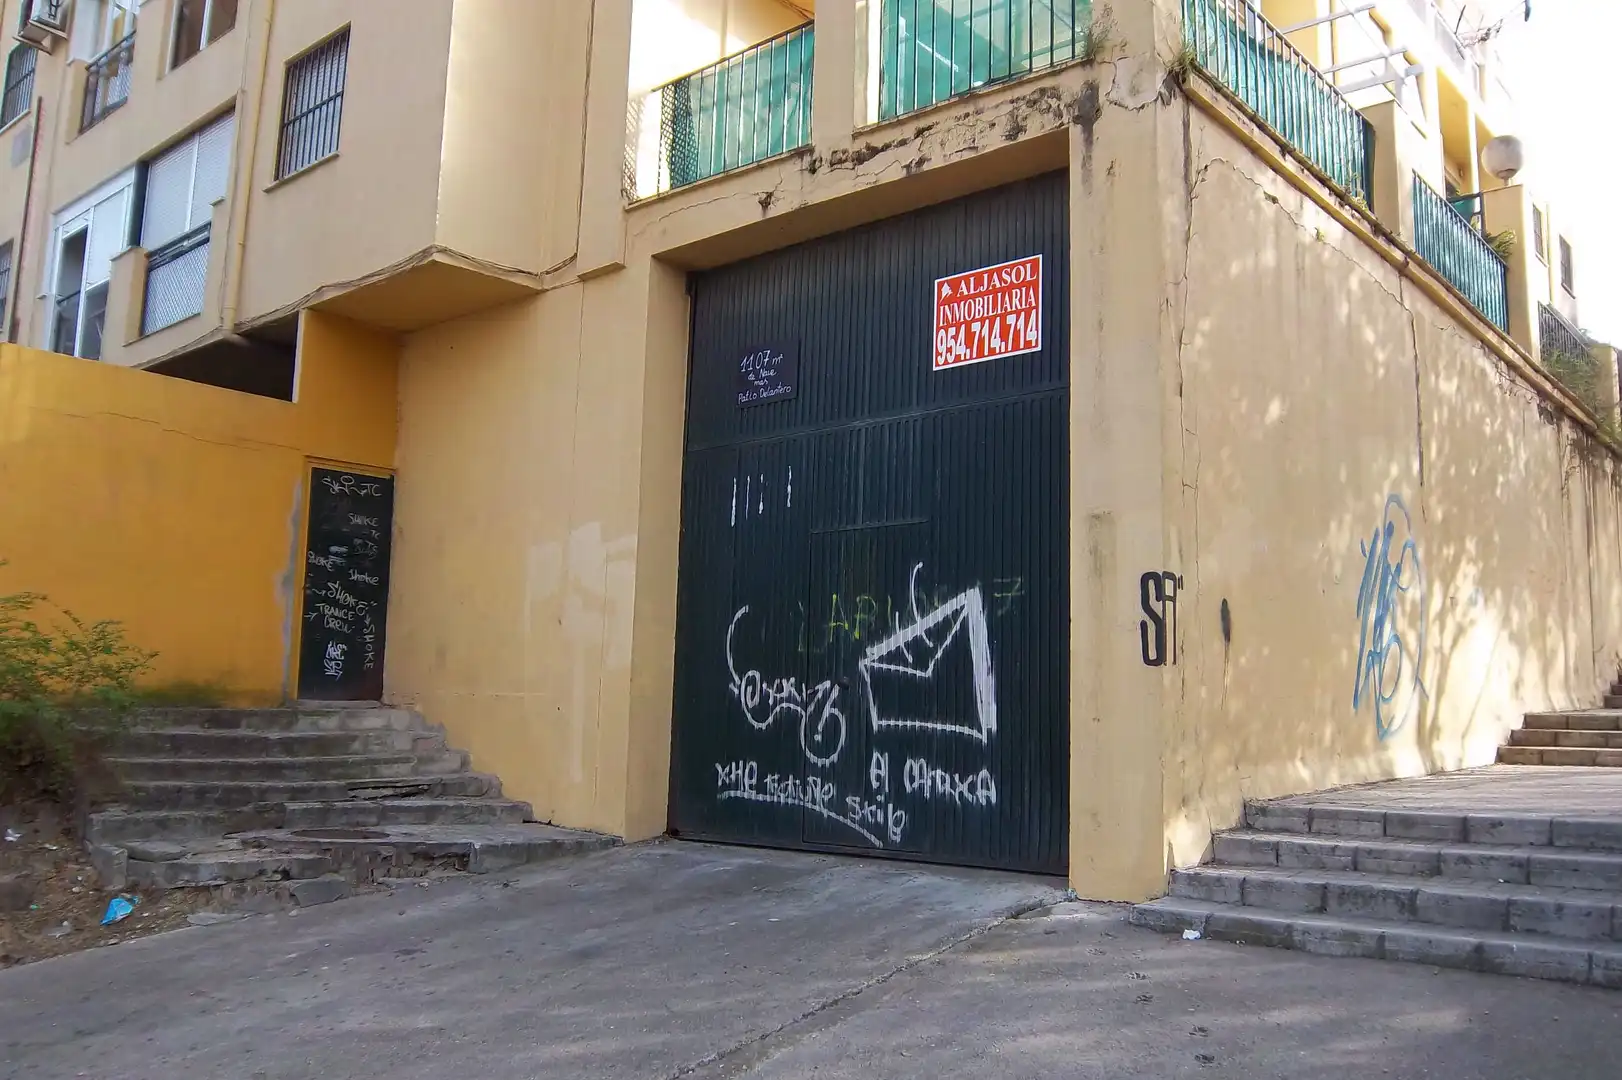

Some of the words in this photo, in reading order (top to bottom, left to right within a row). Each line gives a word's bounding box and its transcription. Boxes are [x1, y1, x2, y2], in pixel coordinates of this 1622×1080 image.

[957, 263, 1037, 297] ALJASOL
[939, 286, 1036, 327] INMOBILIARIA
[937, 308, 1037, 365] 954.714.714
[740, 350, 770, 372] 1107
[738, 390, 757, 404] Patio
[759, 381, 791, 398] Delantero
[314, 602, 356, 621] TRANCE
